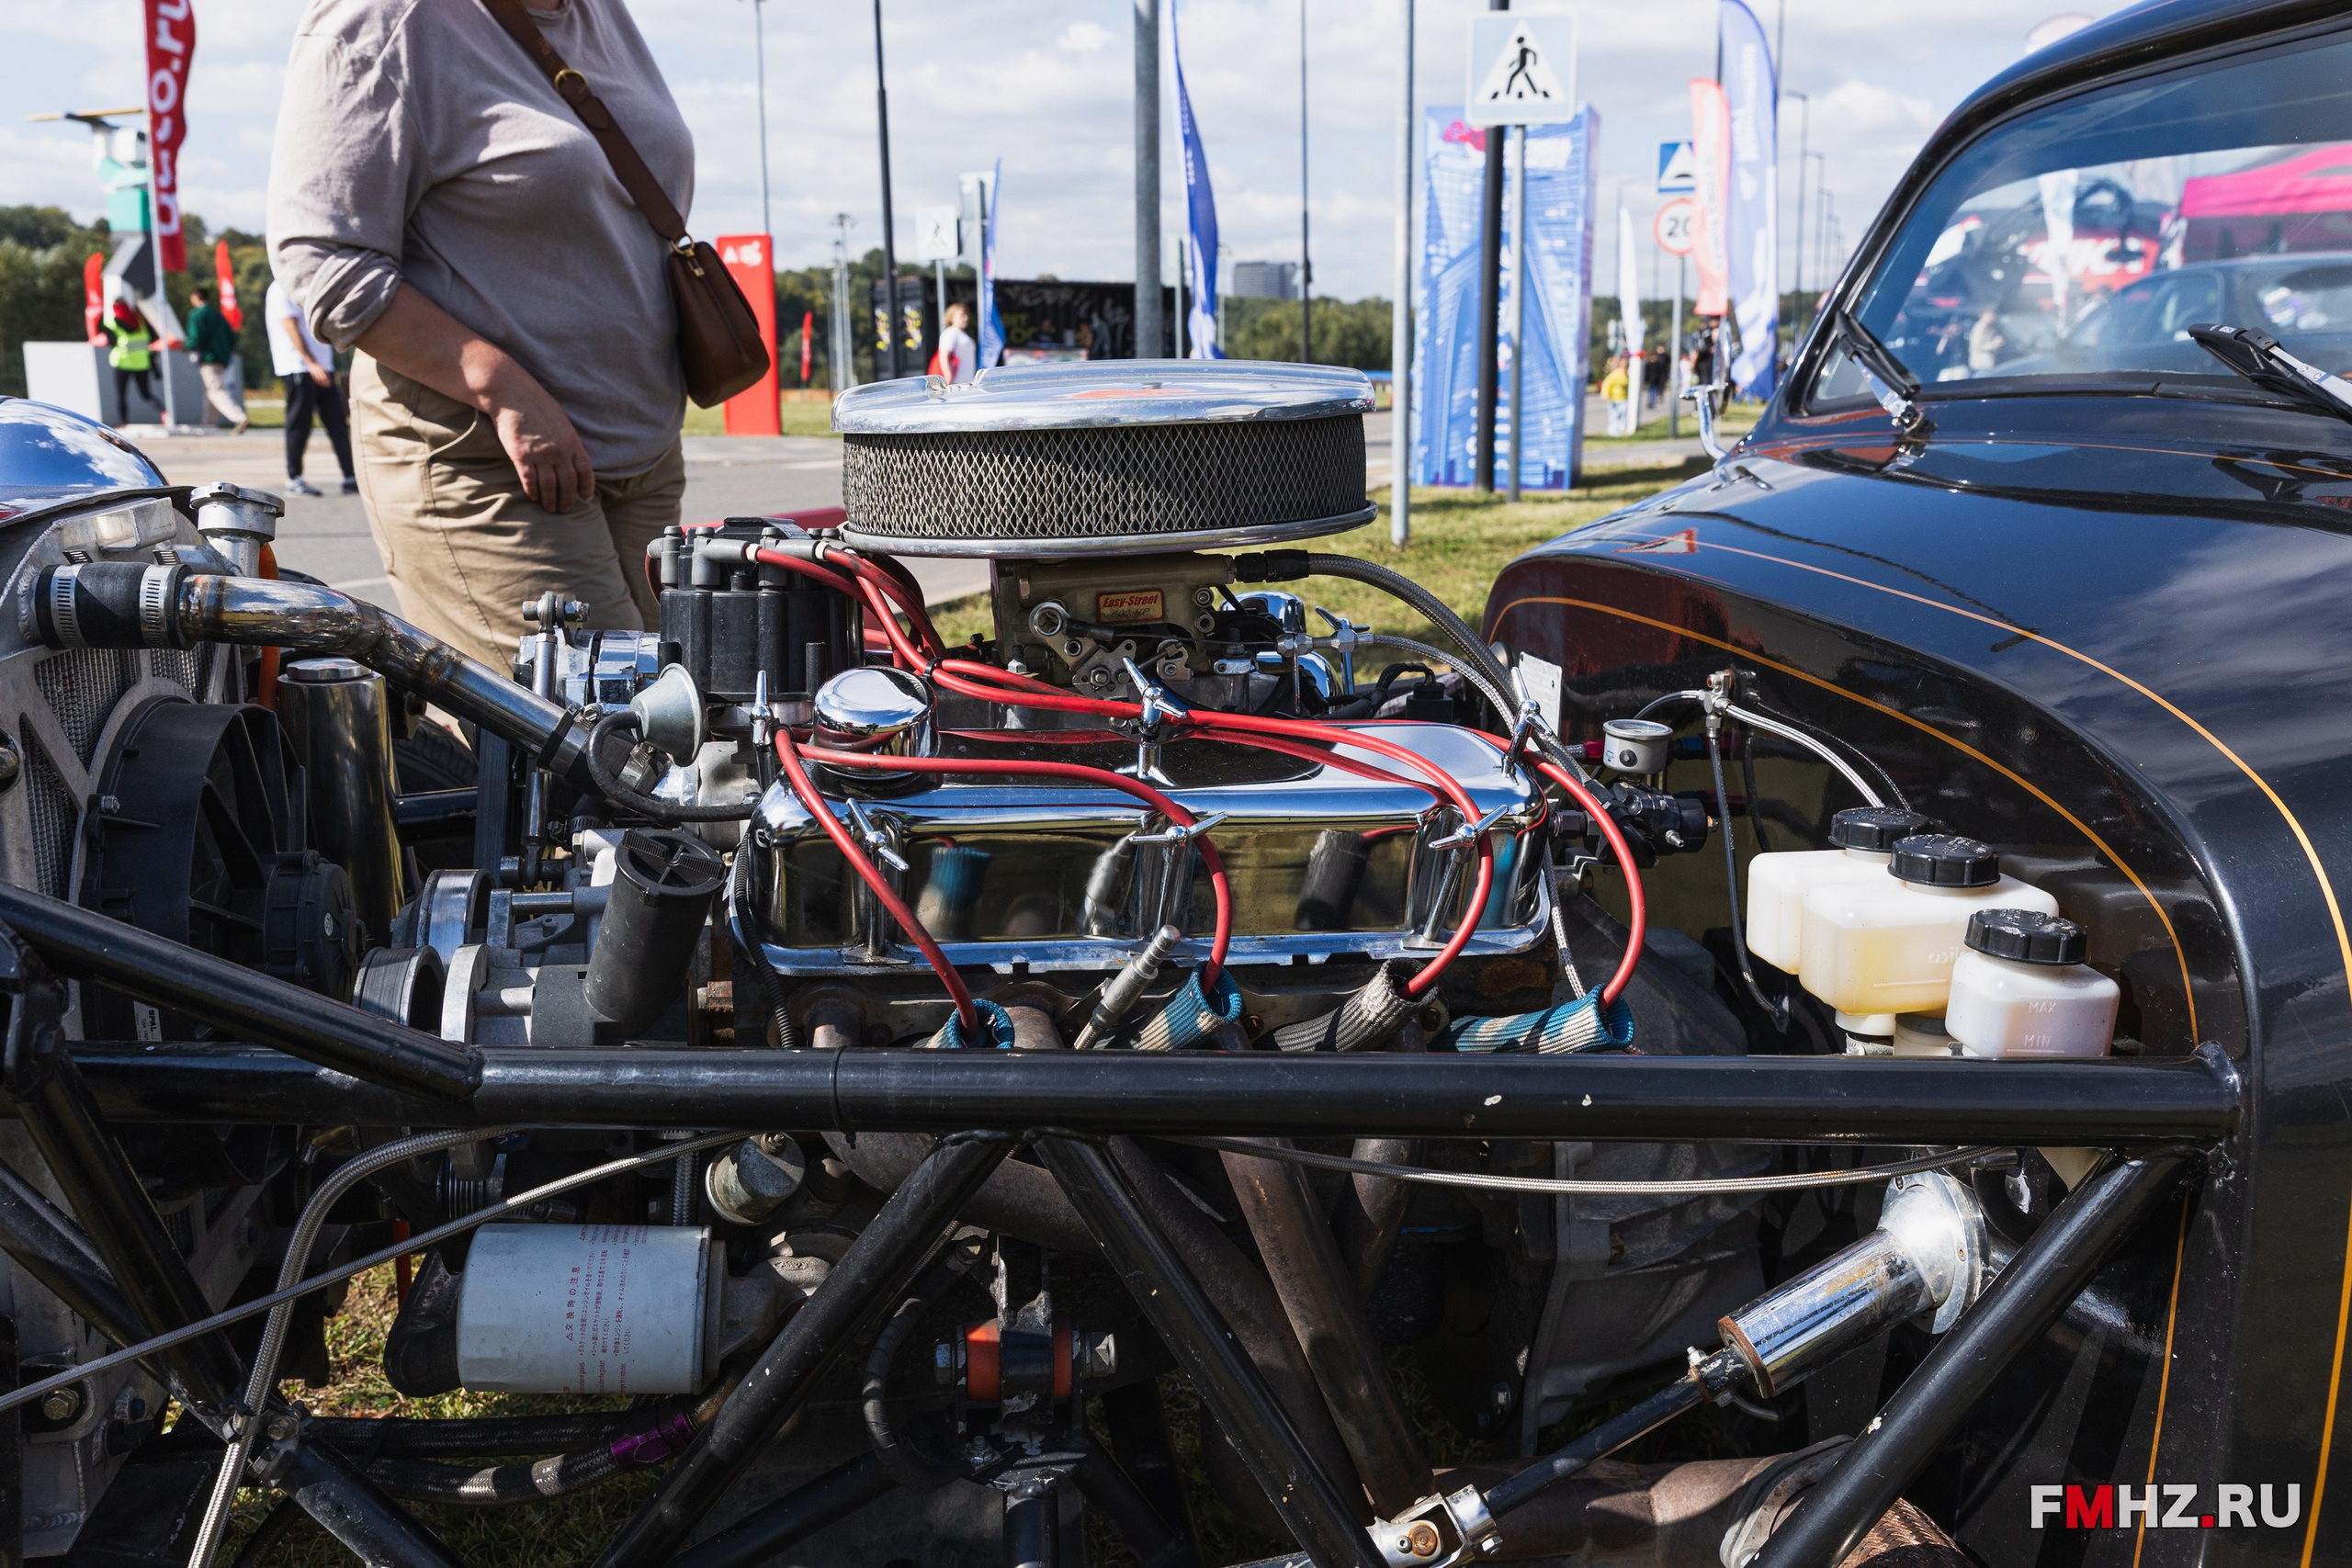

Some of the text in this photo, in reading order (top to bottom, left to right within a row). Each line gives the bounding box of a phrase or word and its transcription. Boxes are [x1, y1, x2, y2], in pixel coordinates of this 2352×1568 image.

[1103, 594, 1159, 608] Easy-Street
[2029, 1001, 2056, 1014] MAX
[149, 1010, 157, 1032] SPAL
[2024, 1034, 2052, 1047] MIN
